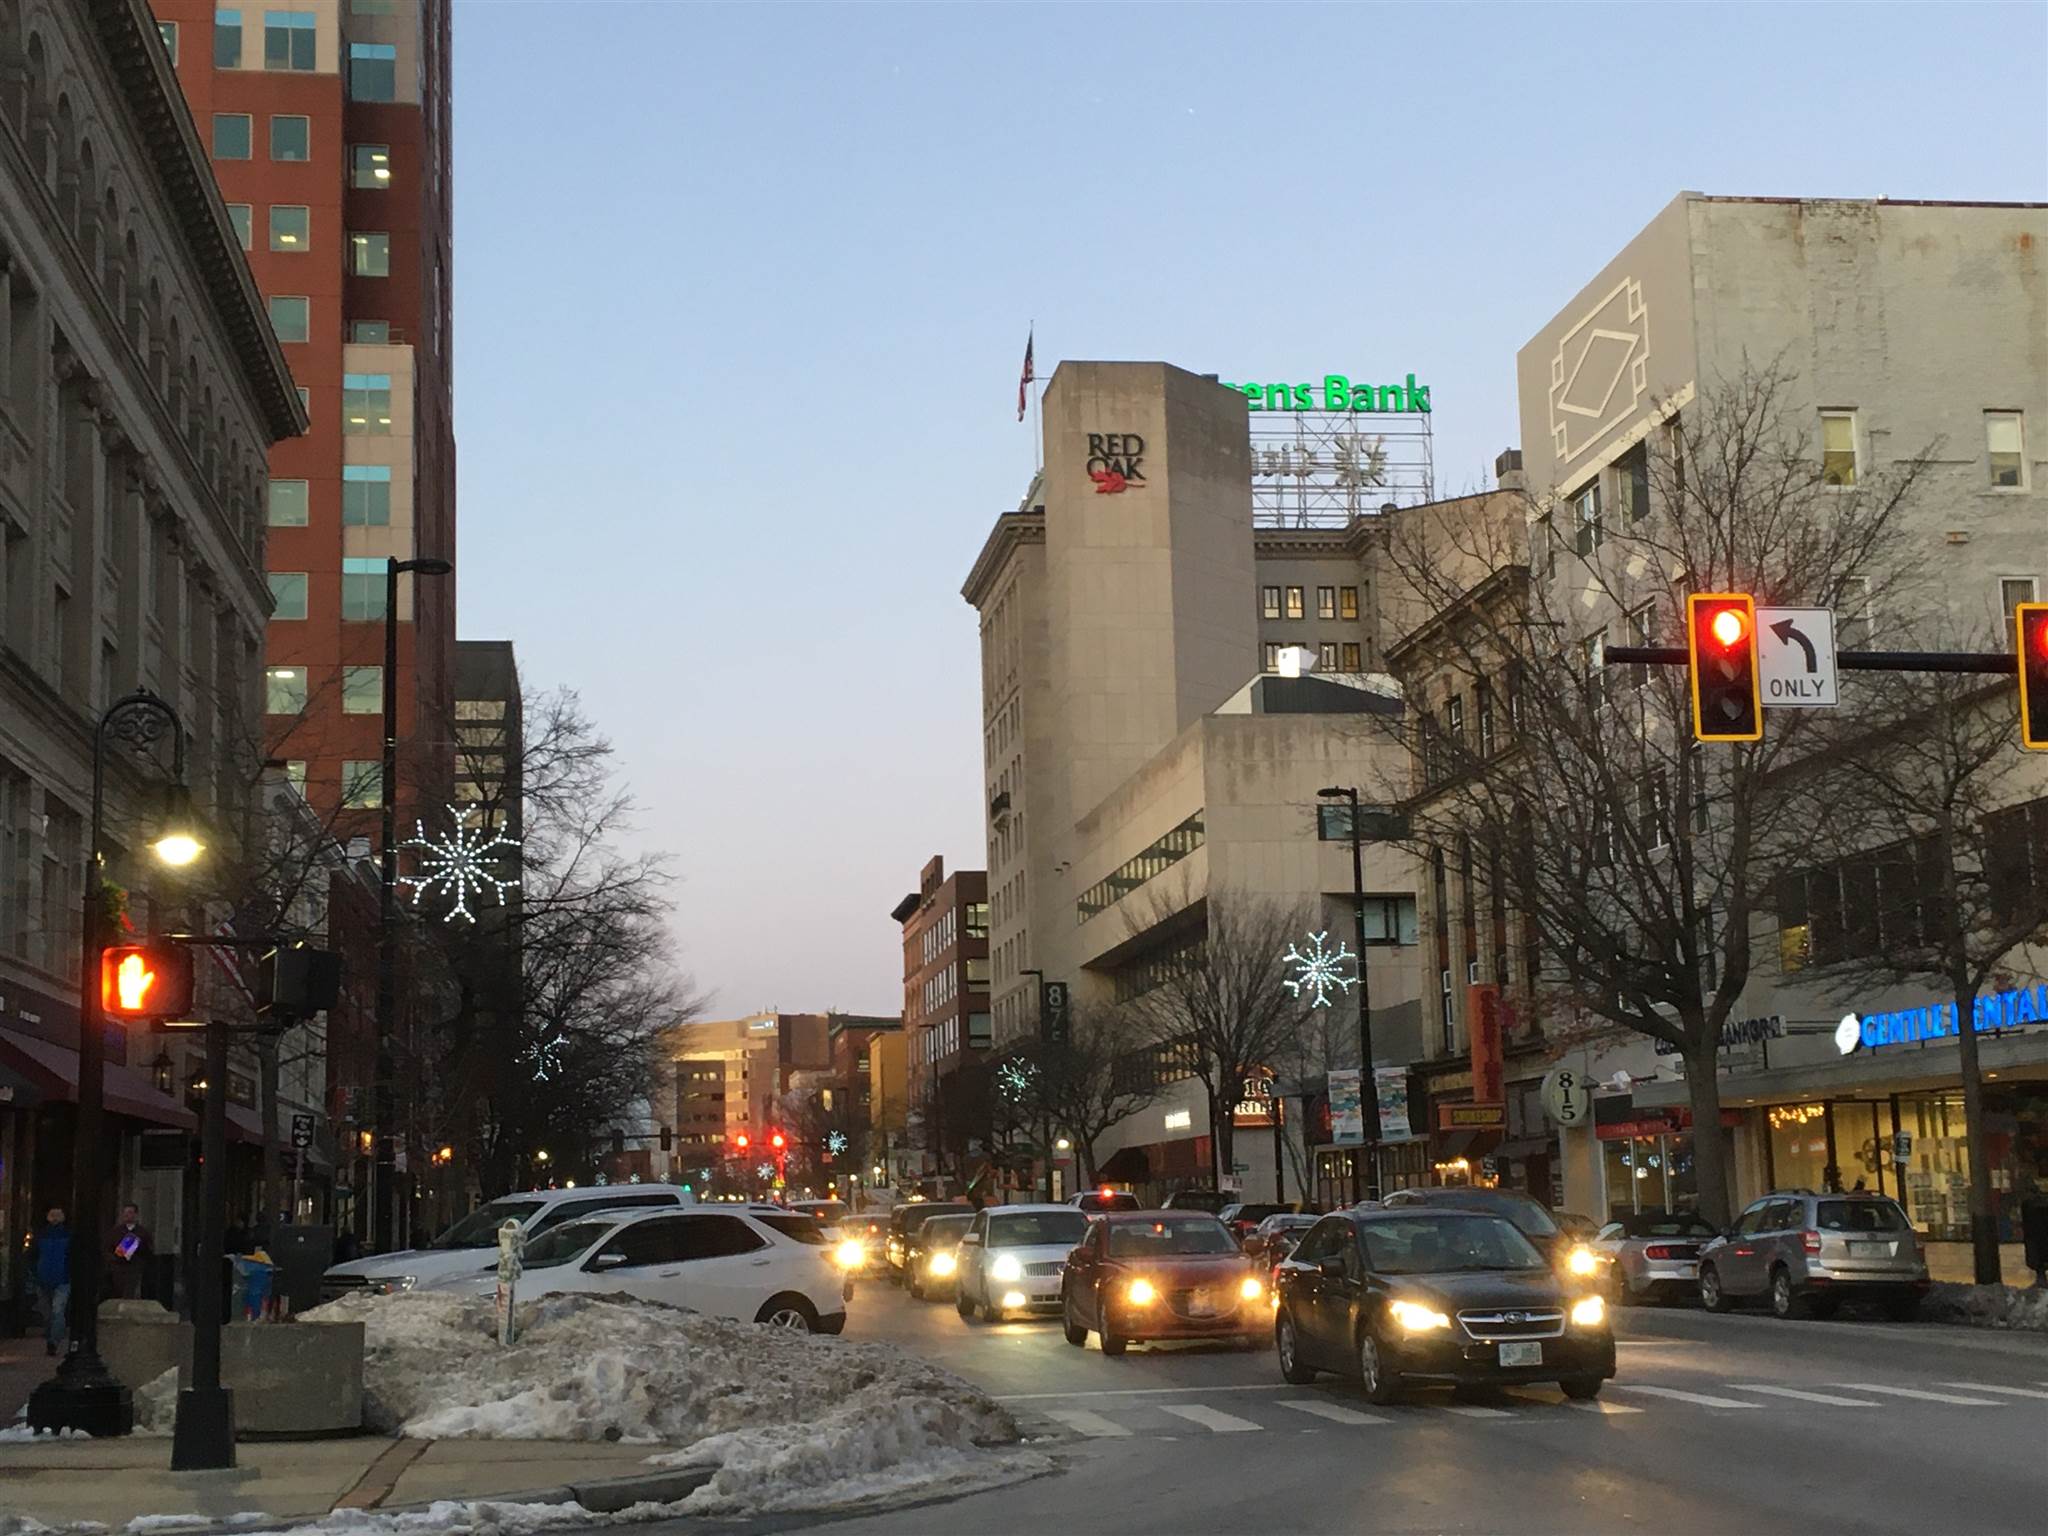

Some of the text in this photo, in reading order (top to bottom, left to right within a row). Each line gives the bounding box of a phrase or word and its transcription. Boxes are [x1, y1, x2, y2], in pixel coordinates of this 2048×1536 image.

[1223, 373, 1432, 413] ens Bank
[1088, 433, 1145, 457] RED
[1086, 458, 1147, 481] OAK
[1769, 678, 1825, 698] ONLY
[1861, 1002, 1945, 1048] GENTLE
[1558, 1072, 1576, 1121] 815
